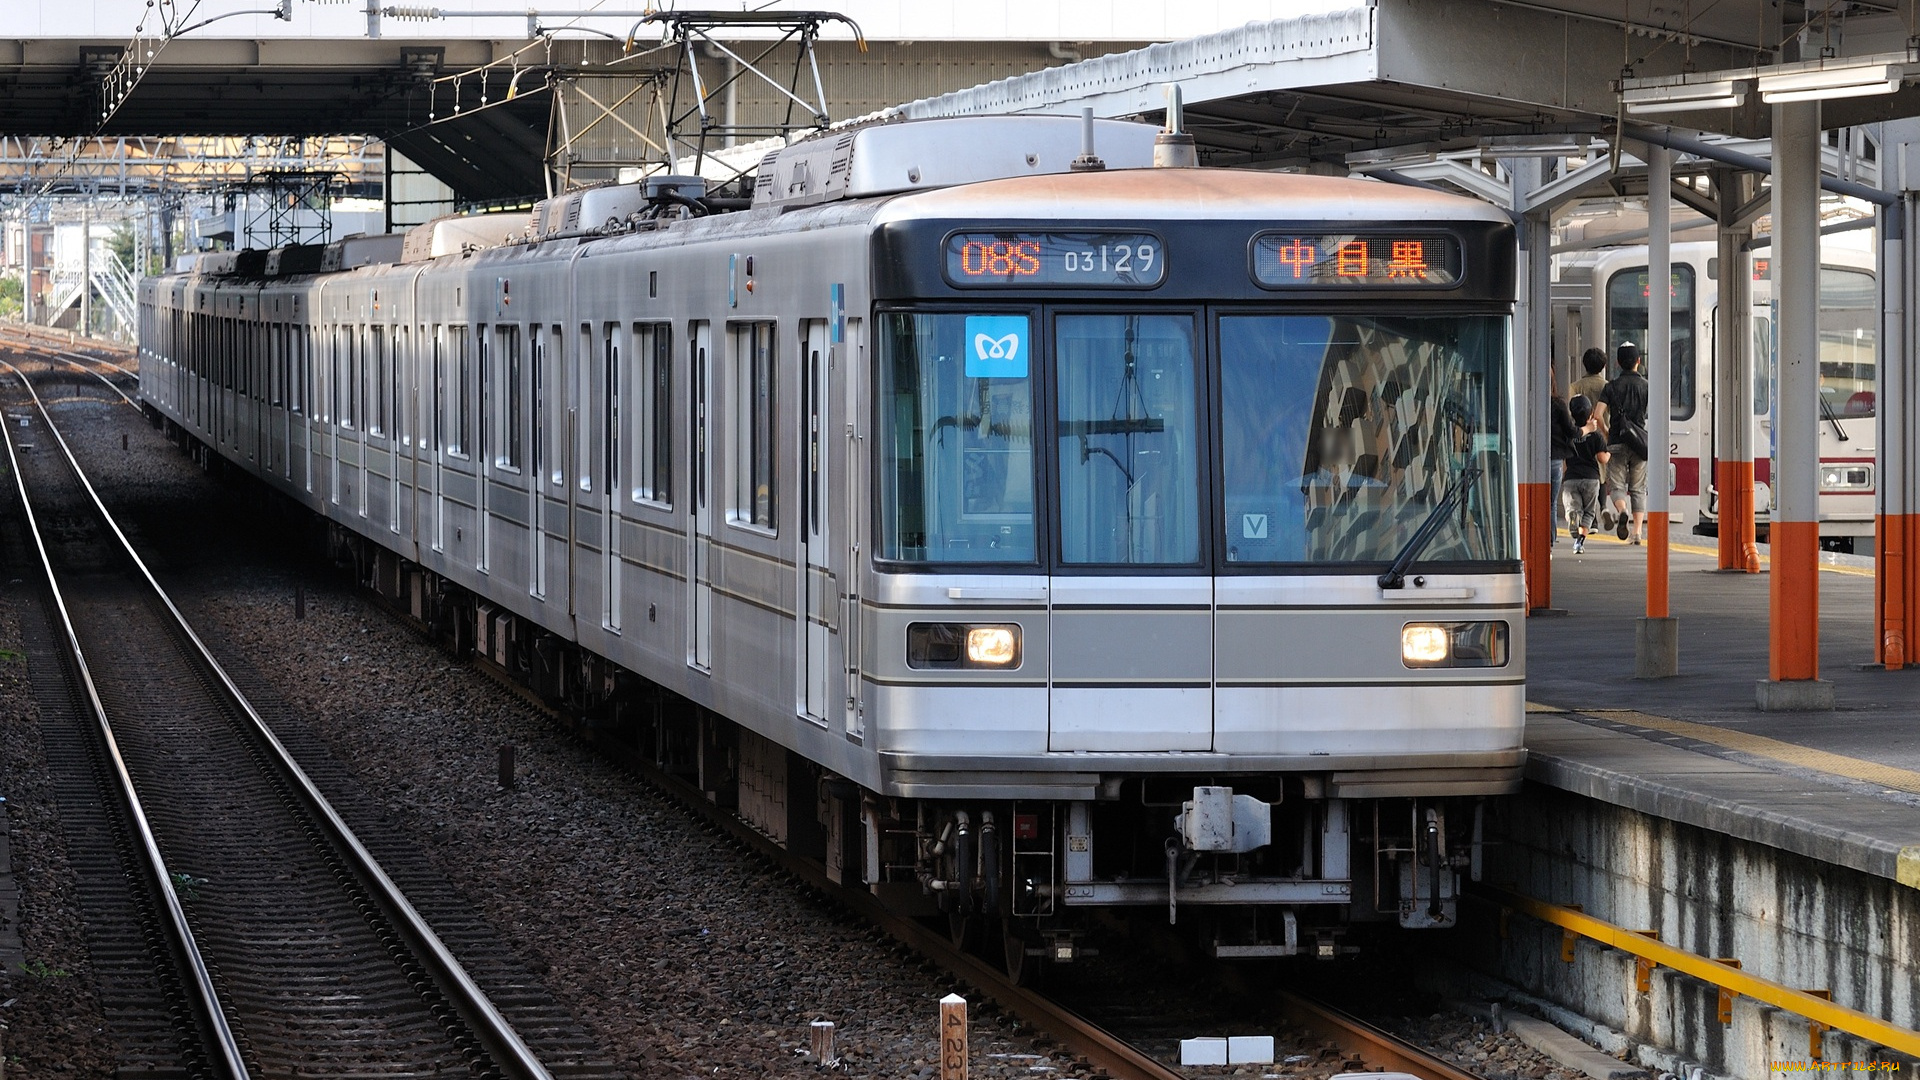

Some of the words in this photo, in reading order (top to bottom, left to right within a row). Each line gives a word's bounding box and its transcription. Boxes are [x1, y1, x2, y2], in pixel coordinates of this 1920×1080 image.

[962, 241, 1040, 275] 08S
[1064, 244, 1155, 273] 03129
[1280, 238, 1427, 278] 中目黒
[1246, 516, 1265, 536] V
